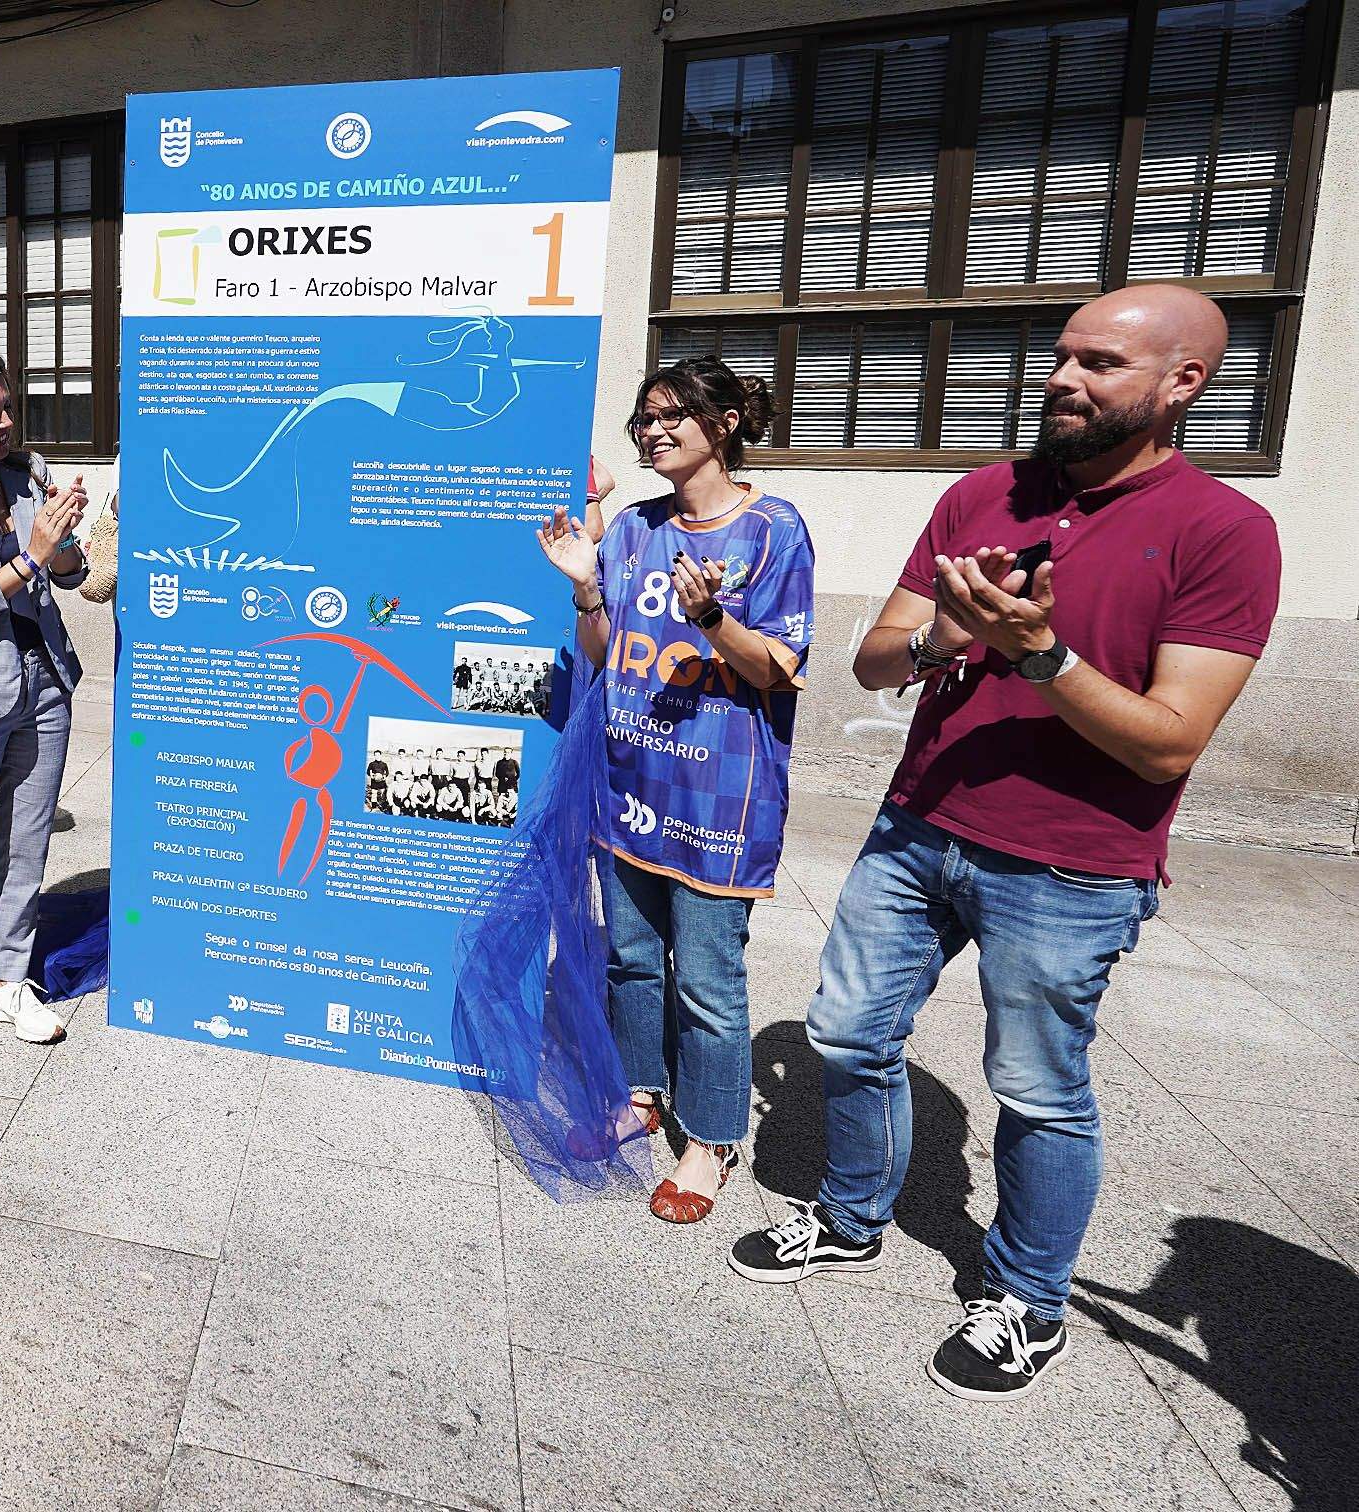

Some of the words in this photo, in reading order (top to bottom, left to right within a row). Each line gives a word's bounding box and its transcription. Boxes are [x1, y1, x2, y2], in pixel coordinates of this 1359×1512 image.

[195, 130, 226, 138] Concello
[195, 138, 204, 146] de
[204, 137, 244, 146] Pontevedra
[466, 134, 565, 148] visit-pontevedra.com
[239, 182, 297, 199] ANOS
[303, 180, 330, 198] DE
[336, 173, 424, 197] CAMIÑO
[228, 225, 372, 257] ORIXES
[528, 212, 575, 306] 1
[215, 278, 260, 298] Faro
[270, 278, 279, 297] 1
[305, 277, 412, 302] Arzobispo
[421, 276, 498, 298] Malvar
[185, 335, 199, 343] que
[205, 334, 231, 342] valente
[231, 334, 263, 343] guerreiro
[264, 334, 289, 343] Teucro,
[290, 334, 320, 343] arqueiro
[139, 358, 167, 367] vagando
[168, 358, 195, 366] durante
[214, 358, 230, 368] polo
[257, 360, 284, 368] procura
[285, 359, 300, 367] dun
[138, 370, 164, 378] destino,
[195, 371, 227, 380] esgotado
[249, 371, 274, 380] rumbo,
[352, 460, 384, 469] Leucoíña
[387, 462, 431, 471] descubriulle
[447, 463, 467, 473] lugar
[470, 465, 501, 474] sagrado
[504, 466, 524, 474] onde
[536, 466, 547, 475] río
[551, 466, 572, 475] Lérez
[351, 483, 398, 494] superación
[424, 486, 474, 495] sentimento
[495, 489, 536, 497] pertenza
[541, 490, 570, 499] serían
[192, 596, 228, 604] Pontevedra
[436, 621, 528, 635] visit-pontevedra.com
[644, 690, 732, 715] TECHNOLOGY
[610, 706, 674, 736] TEUCRO
[156, 751, 213, 766] ARZOBISPO
[215, 757, 255, 771] MALVAR
[155, 775, 186, 787] PRAZA
[189, 778, 238, 793] FERRERÍA
[155, 801, 194, 814] TEATRO
[196, 806, 248, 821] PRINCIPAL
[166, 816, 236, 834] (EXPOSICIÓN)
[663, 816, 746, 844] Deputación
[153, 841, 184, 854] PRAZA
[187, 845, 201, 856] DE
[203, 847, 244, 861] TEUCRO
[662, 828, 744, 856] Pontevedra
[152, 870, 183, 883] PRAZA
[253, 883, 307, 900] ESCUDERO
[152, 895, 198, 910] PAVILLÓN
[201, 902, 222, 913] DOS
[224, 905, 277, 921] DEPORTES
[204, 932, 237, 946] Segue
[242, 939, 250, 948] o
[255, 941, 287, 953] ronsel
[292, 945, 306, 956] da
[312, 950, 338, 961] nosa
[344, 954, 374, 966] serea
[380, 958, 433, 976] Leucoíña.
[204, 947, 248, 963] Percorre
[247, 956, 267, 966] con
[268, 957, 287, 969] nós
[288, 962, 302, 972] os
[302, 963, 316, 974] 80
[317, 966, 343, 978] anos
[344, 968, 359, 980] de
[359, 971, 402, 986] Camiño
[402, 977, 430, 992] Azul.
[354, 1009, 404, 1028] XUNTA
[354, 1024, 372, 1036] DE
[376, 1026, 434, 1046] GALICIA
